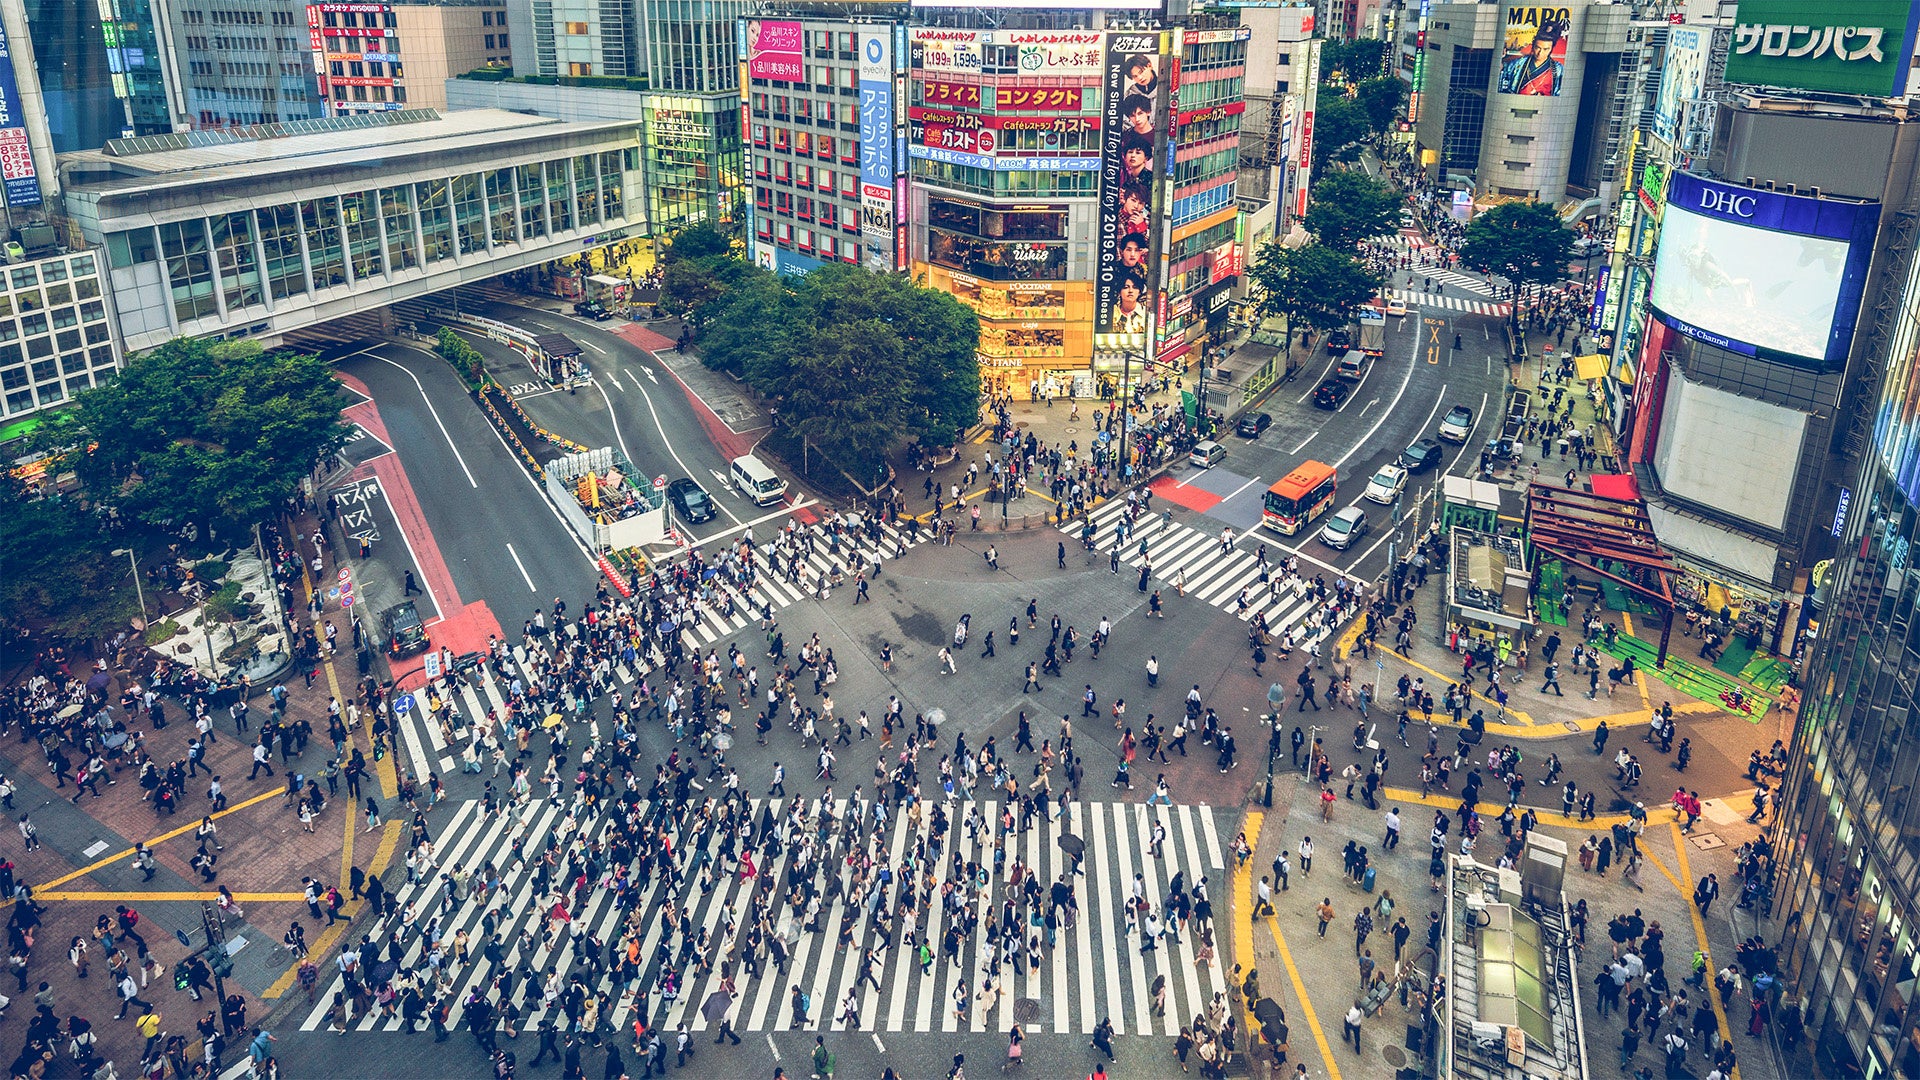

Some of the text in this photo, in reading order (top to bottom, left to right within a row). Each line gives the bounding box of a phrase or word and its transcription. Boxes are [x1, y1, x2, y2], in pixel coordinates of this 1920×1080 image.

[323, 4, 348, 12] カラオケ
[771, 26, 799, 37] 品川スキン
[916, 29, 977, 42] しゃぶしゃぶバイキング
[1010, 33, 1100, 44] しゃぶしゃぶバイキング
[771, 38, 797, 48] クリニック
[1735, 23, 1884, 63] サロンパス
[912, 48, 923, 59] 9F
[1047, 49, 1100, 67] しゃぶ葉
[757, 62, 800, 77] 品川美容外科
[862, 65, 888, 77] eyecity
[1111, 64, 1120, 89] New
[925, 83, 979, 102] プライス
[997, 89, 1079, 105] コンタクト
[1107, 91, 1119, 126] Single
[1211, 107, 1227, 122] ガスト
[650, 122, 711, 133] MARK CITY
[956, 113, 983, 130] ガスト
[1003, 118, 1092, 133] Caféレストラン ガスト
[863, 89, 877, 177] アイシティ
[878, 91, 889, 179] コンタクトの
[912, 126, 924, 138] 7F
[927, 128, 941, 137] Café
[942, 129, 975, 150] ガスト
[931, 149, 979, 165] 英会話イーオン
[1000, 160, 1023, 168] AEON
[1029, 159, 1099, 169] 英会話イーオン
[1700, 187, 1757, 218] DHC
[1101, 213, 1116, 282] 2019.6.10
[1009, 282, 1052, 291] L'OCCITANE
[1100, 286, 1110, 326] Release
[1210, 288, 1231, 309] LUSH
[1680, 323, 1729, 348] DHC Channel
